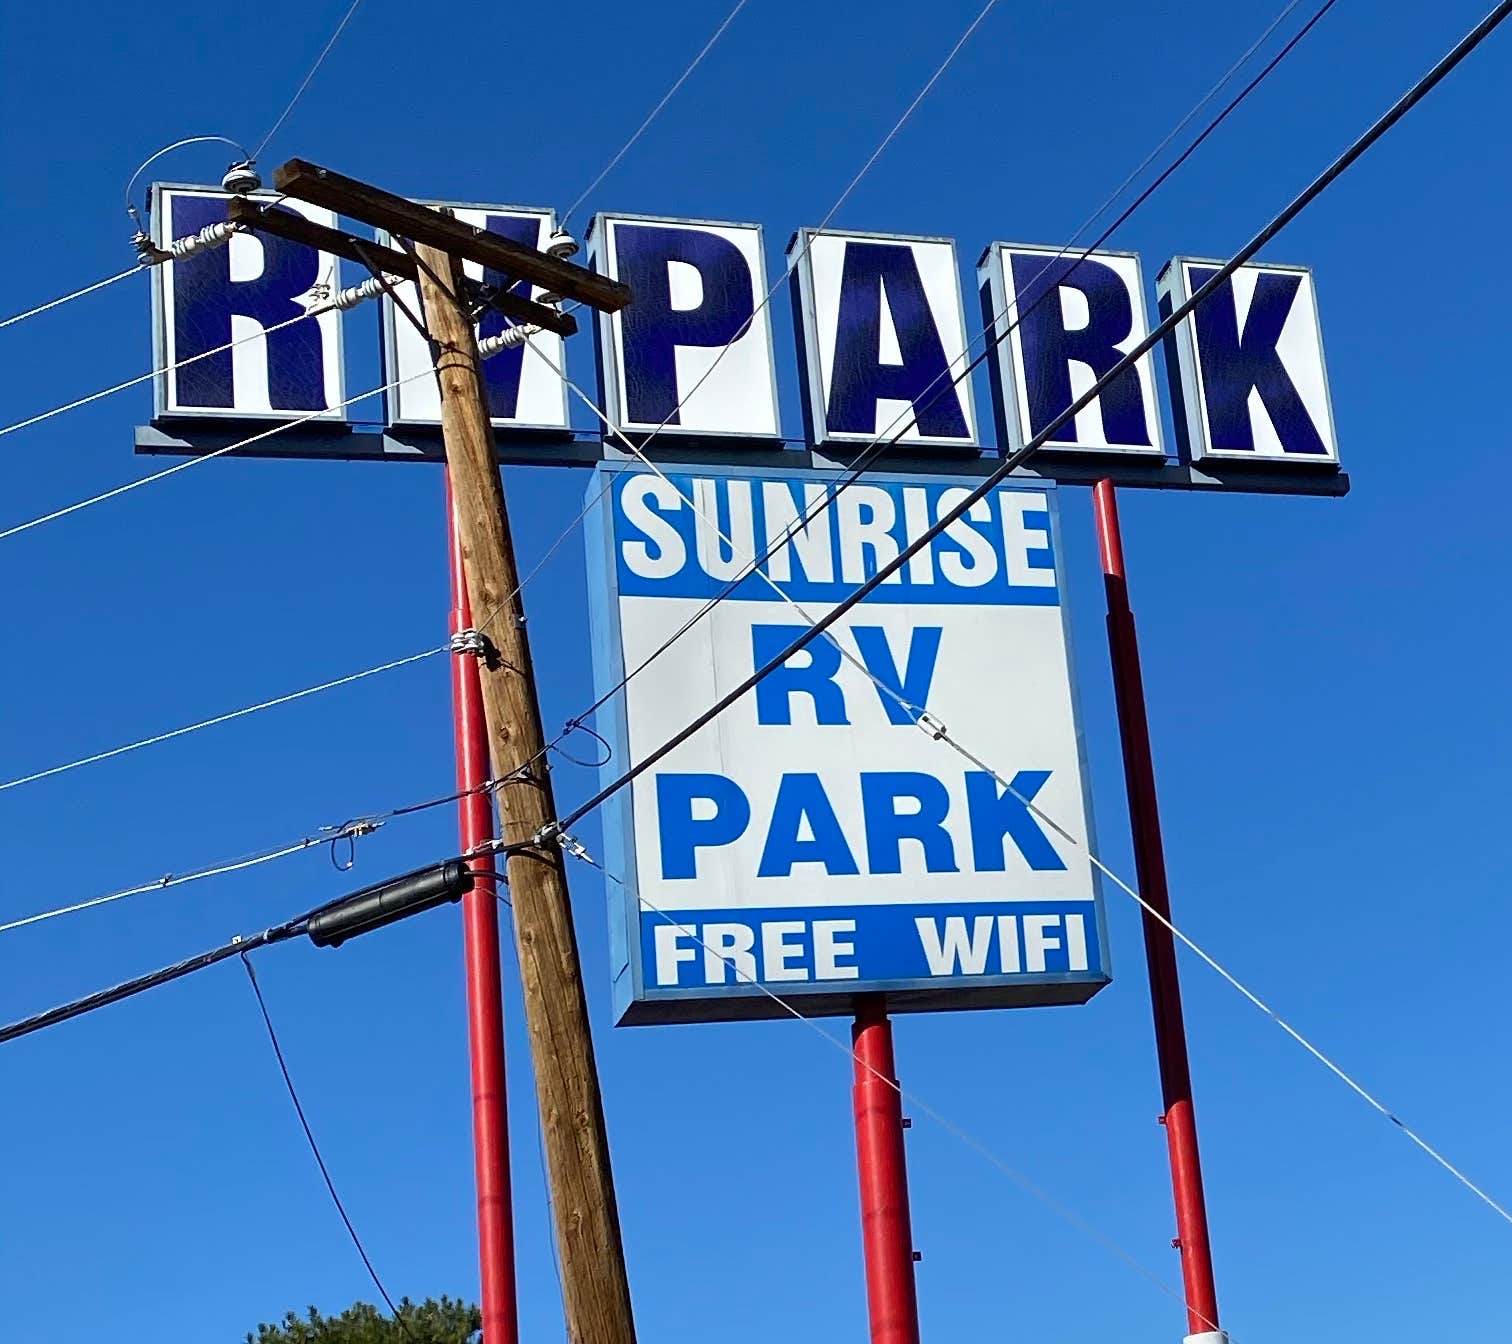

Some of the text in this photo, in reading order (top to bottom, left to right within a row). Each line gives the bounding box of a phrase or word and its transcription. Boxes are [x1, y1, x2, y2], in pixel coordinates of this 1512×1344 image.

[613, 224, 1328, 455] PARK
[620, 475, 1056, 588] SUNRISE
[752, 624, 943, 727] RV
[655, 770, 1068, 881] PARK
[654, 914, 1088, 986] FREE WIFI
